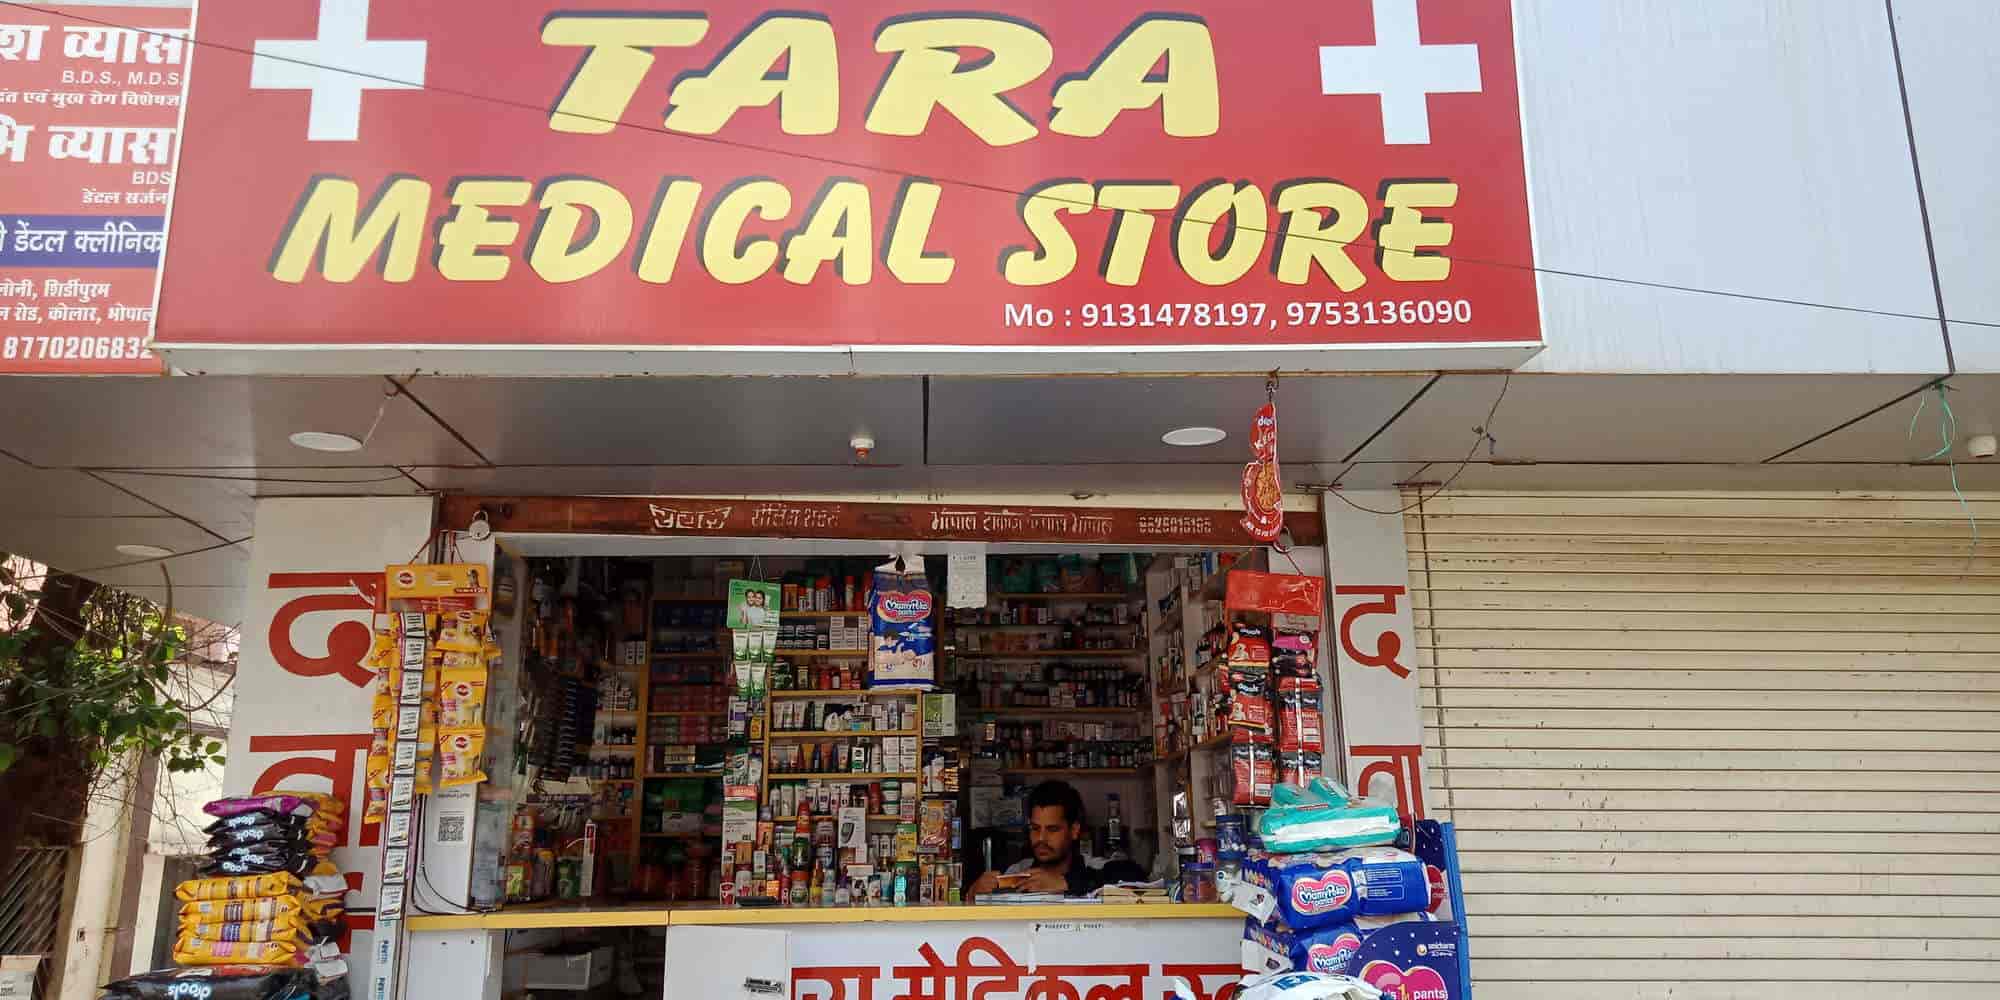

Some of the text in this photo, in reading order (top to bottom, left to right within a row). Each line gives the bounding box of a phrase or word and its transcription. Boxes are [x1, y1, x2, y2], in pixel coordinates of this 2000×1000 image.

[64, 26, 190, 64] व्यास
[540, 11, 1220, 146] TARA
[48, 125, 177, 165] व्यास
[132, 171, 171, 185] BDS
[14, 219, 68, 253] डेंटल
[74, 221, 166, 254] क्लीनिक
[268, 173, 1459, 293] MEDICAL STORE
[1004, 303, 1053, 328] Mo
[1080, 302, 1278, 331] 9131478197,
[1286, 299, 1473, 326] 9753136090
[3, 336, 153, 360] 8770206832
